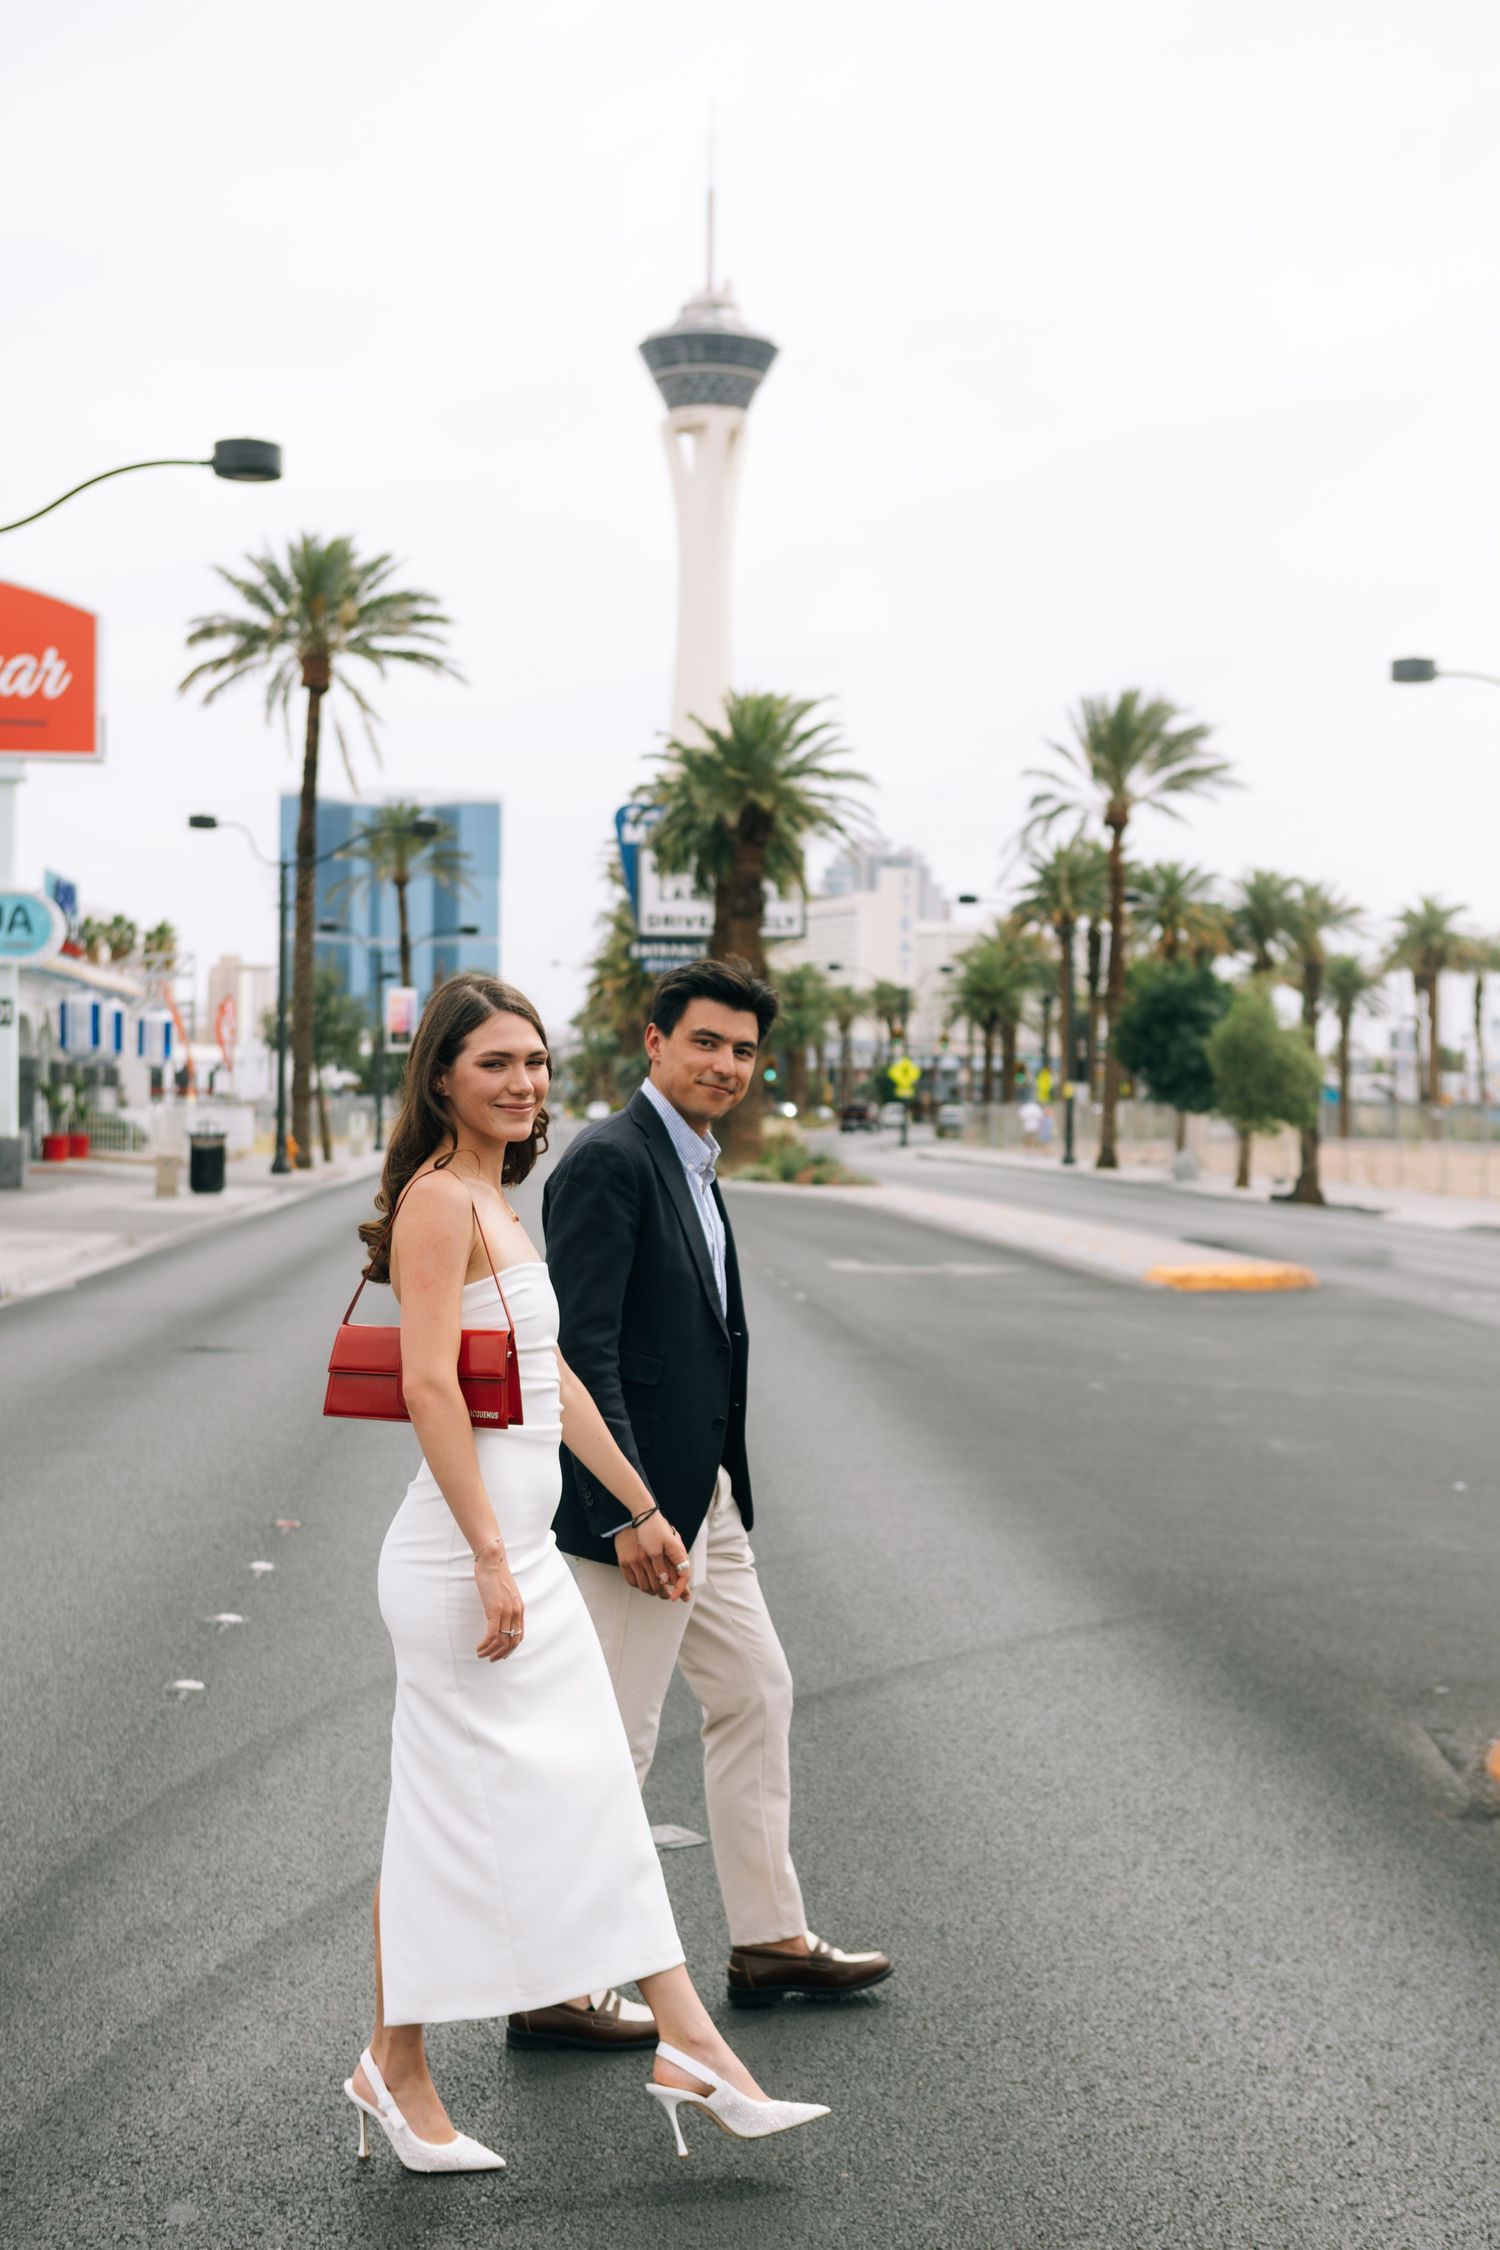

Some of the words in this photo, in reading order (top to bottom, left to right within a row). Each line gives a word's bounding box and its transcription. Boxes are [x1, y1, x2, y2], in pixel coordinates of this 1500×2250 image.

[0, 646, 73, 700] ar
[0, 904, 33, 934] A
[469, 1410, 499, 1420] ACQUEMUS
